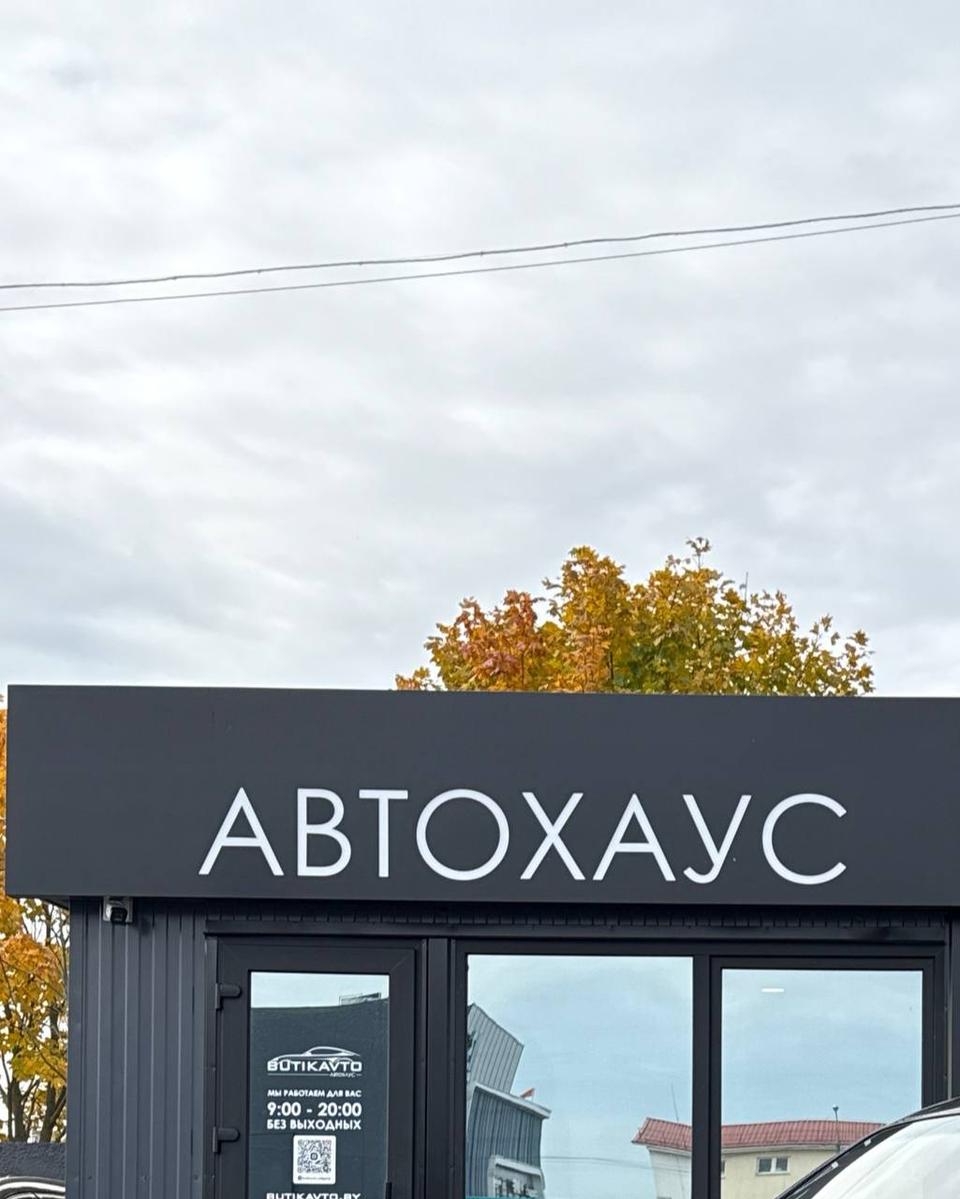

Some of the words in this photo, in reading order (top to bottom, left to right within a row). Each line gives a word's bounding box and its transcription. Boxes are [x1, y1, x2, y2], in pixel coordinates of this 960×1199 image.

[198, 787, 848, 885] АВТОХАУС
[267, 1060, 363, 1072] BUTIKAVTO
[267, 1089, 282, 1097] МЫ
[283, 1089, 325, 1097] РАБОТАЕМ
[326, 1090, 343, 1098] ДЛЯ
[267, 1102, 301, 1116] 9:00
[318, 1102, 362, 1117] 20:00
[266, 1119, 286, 1130] БЕЗ
[290, 1119, 362, 1131] ВЫХОДНЫХ
